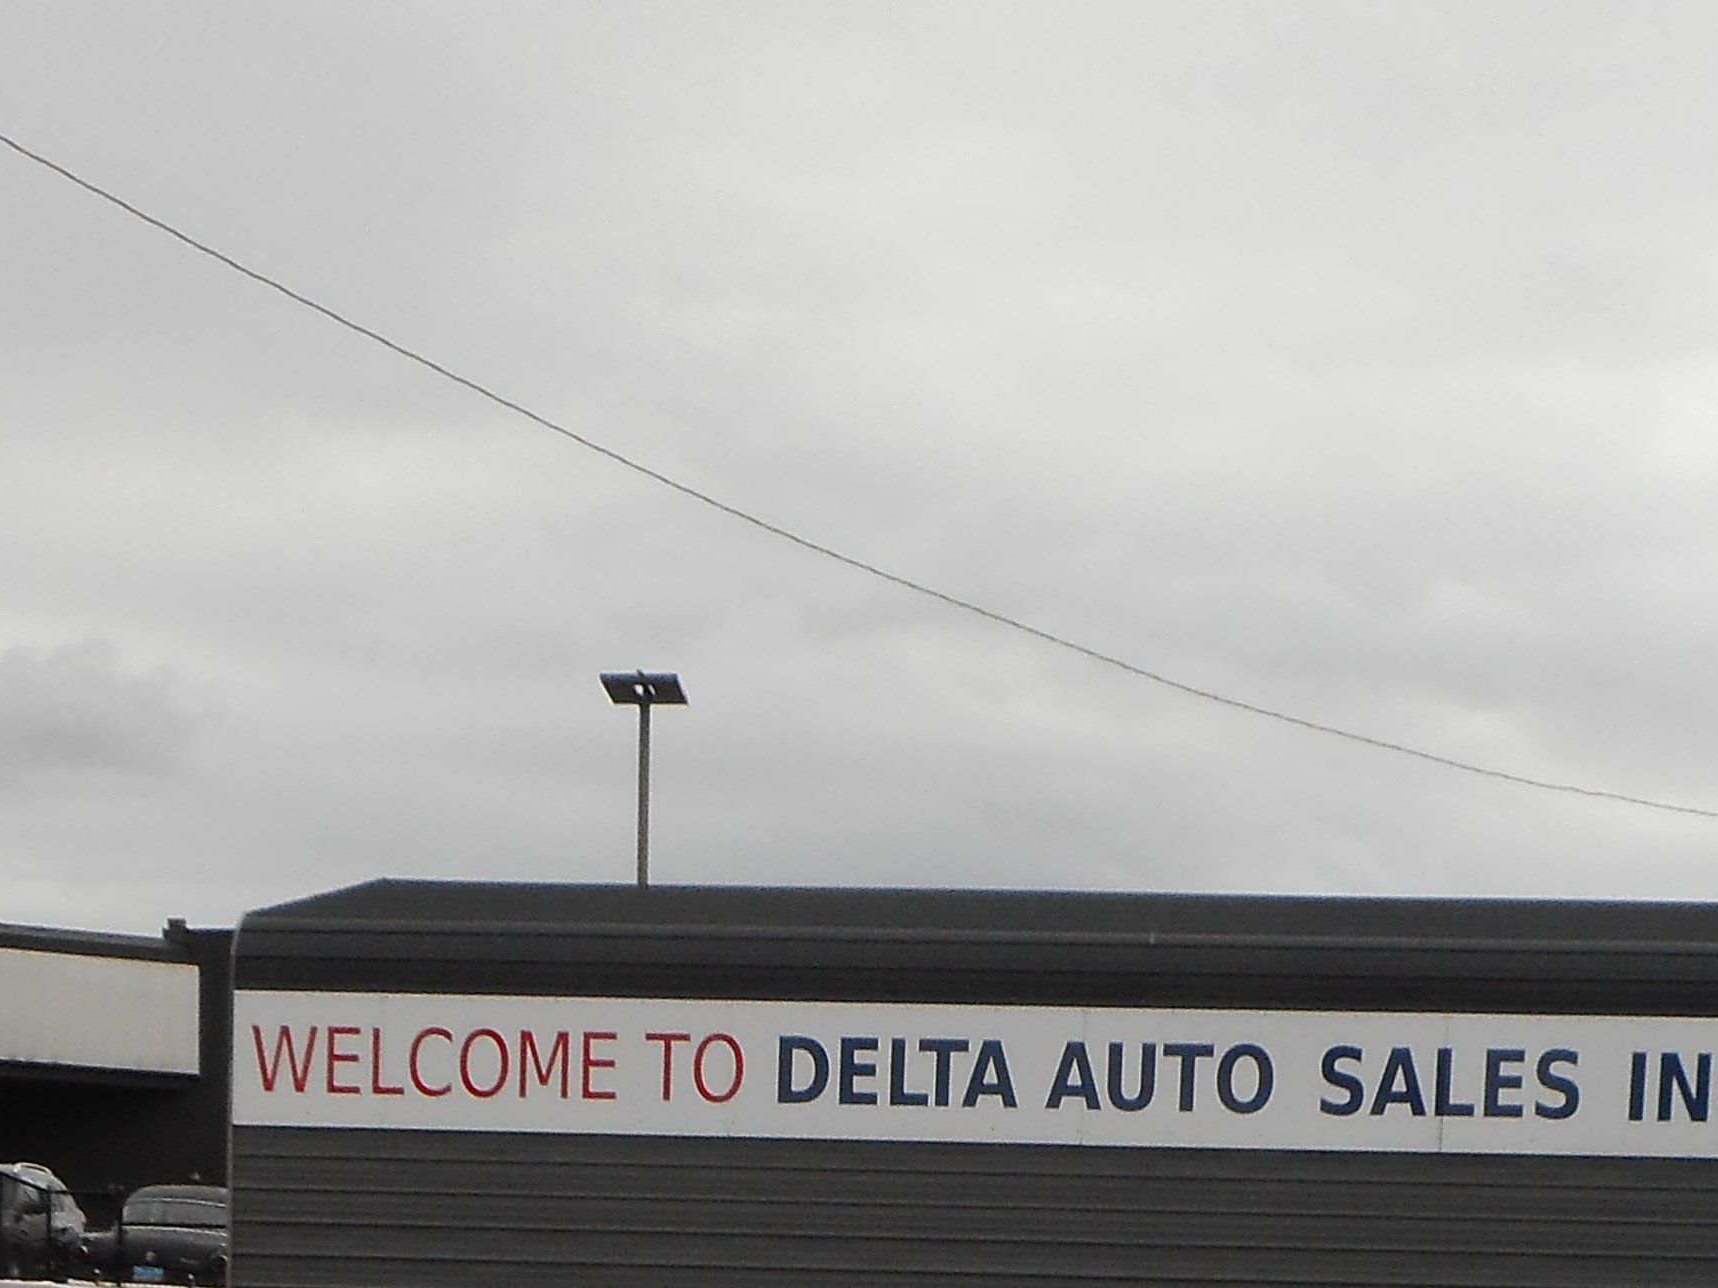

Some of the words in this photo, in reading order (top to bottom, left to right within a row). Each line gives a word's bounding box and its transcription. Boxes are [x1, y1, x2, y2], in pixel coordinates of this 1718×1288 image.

[252, 1024, 619, 1101] WELCOME
[645, 1030, 746, 1104] TO
[777, 1034, 1018, 1110] DELTA
[1044, 1040, 1275, 1115] AUTO
[1319, 1044, 1581, 1121] SALES
